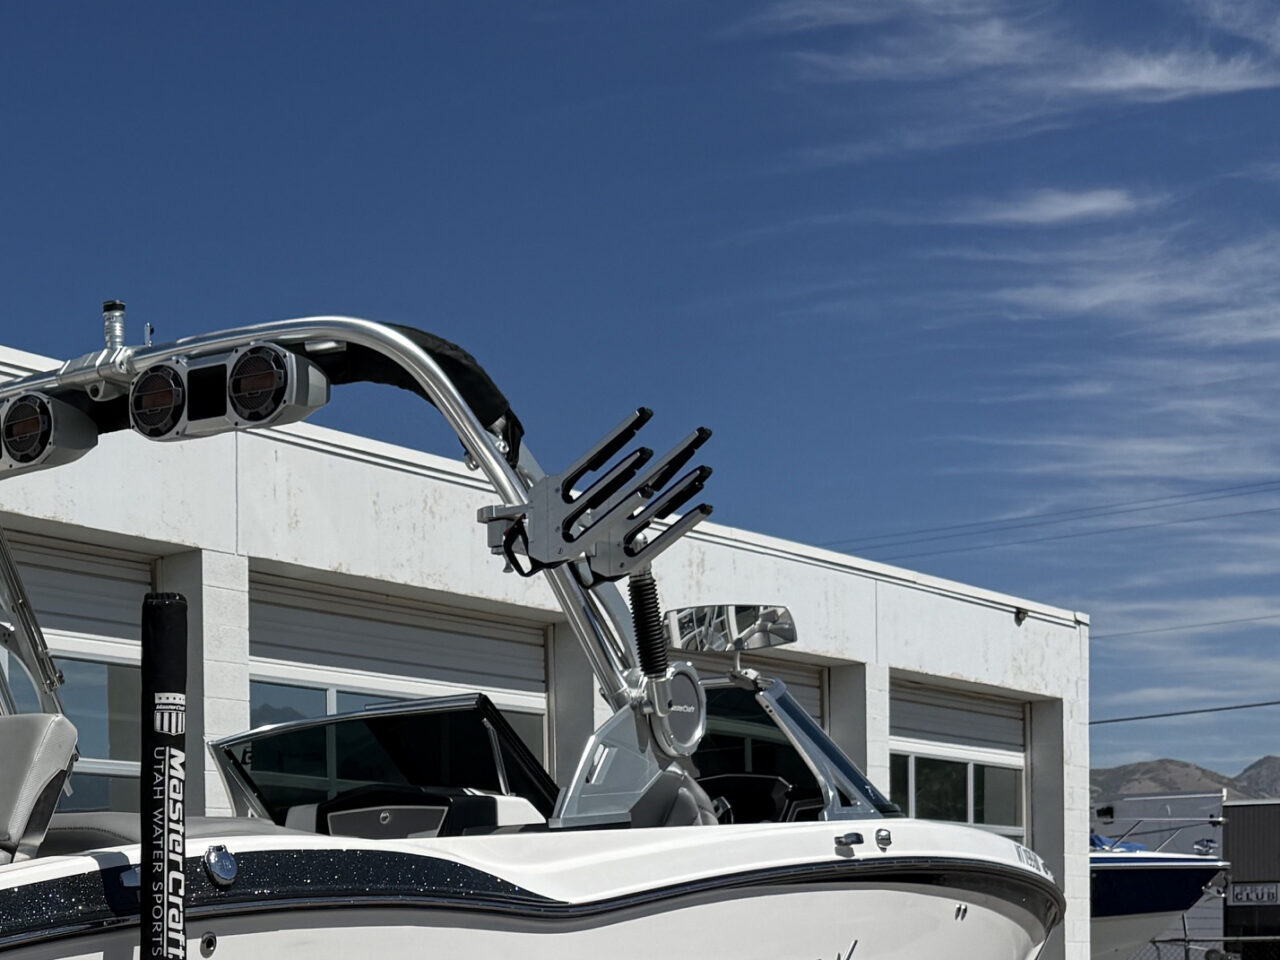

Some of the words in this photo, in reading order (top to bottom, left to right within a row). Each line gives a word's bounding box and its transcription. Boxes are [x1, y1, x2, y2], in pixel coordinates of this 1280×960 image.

[152, 746, 165, 799] UTAH
[152, 808, 165, 873] WATER
[151, 881, 164, 957] SPORTS
